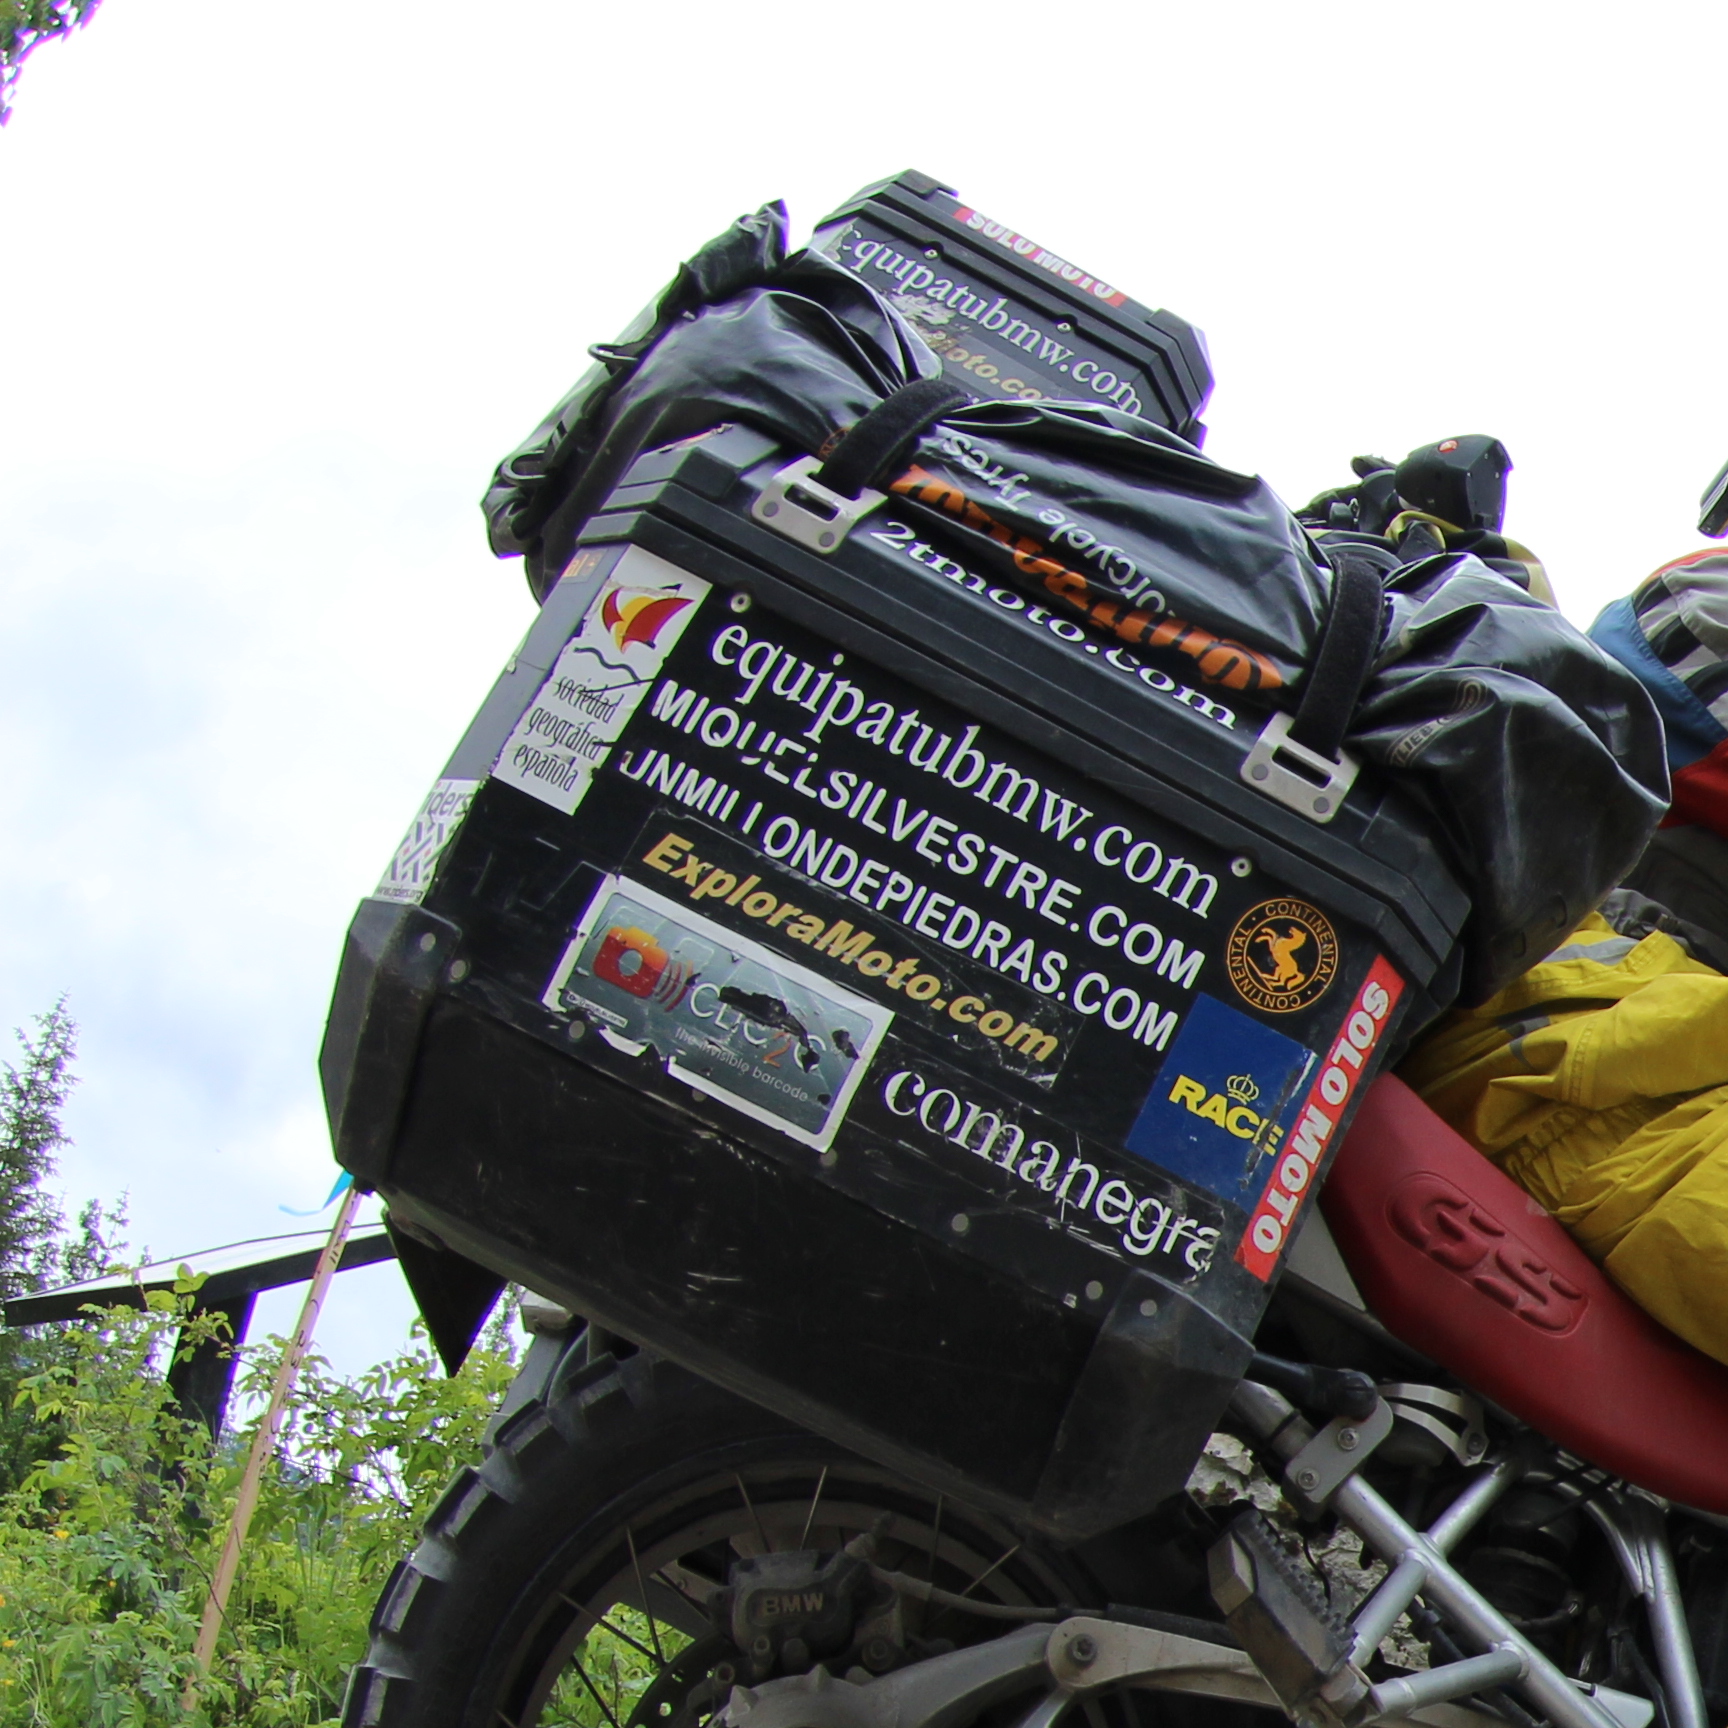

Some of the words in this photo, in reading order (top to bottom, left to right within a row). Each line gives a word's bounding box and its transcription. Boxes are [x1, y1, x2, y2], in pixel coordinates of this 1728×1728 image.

[966, 211, 1038, 256] SOLO
[1033, 245, 1115, 299] MOTO
[943, 434, 1033, 513] Tyres
[1039, 508, 1177, 621] orcycle
[870, 520, 1240, 731] 2tmoto.com
[552, 675, 625, 725] sociedad
[511, 743, 580, 794] española
[710, 622, 1223, 920] equipatubmw.com
[641, 831, 1059, 1065] ExploraMoto.com
[751, 1065, 810, 1102] barcode
[1319, 979, 1391, 1107] SOLO
[884, 1066, 1222, 1279] comanegra
[1251, 1101, 1334, 1254] MOTO
[760, 1592, 824, 1616] BMW
